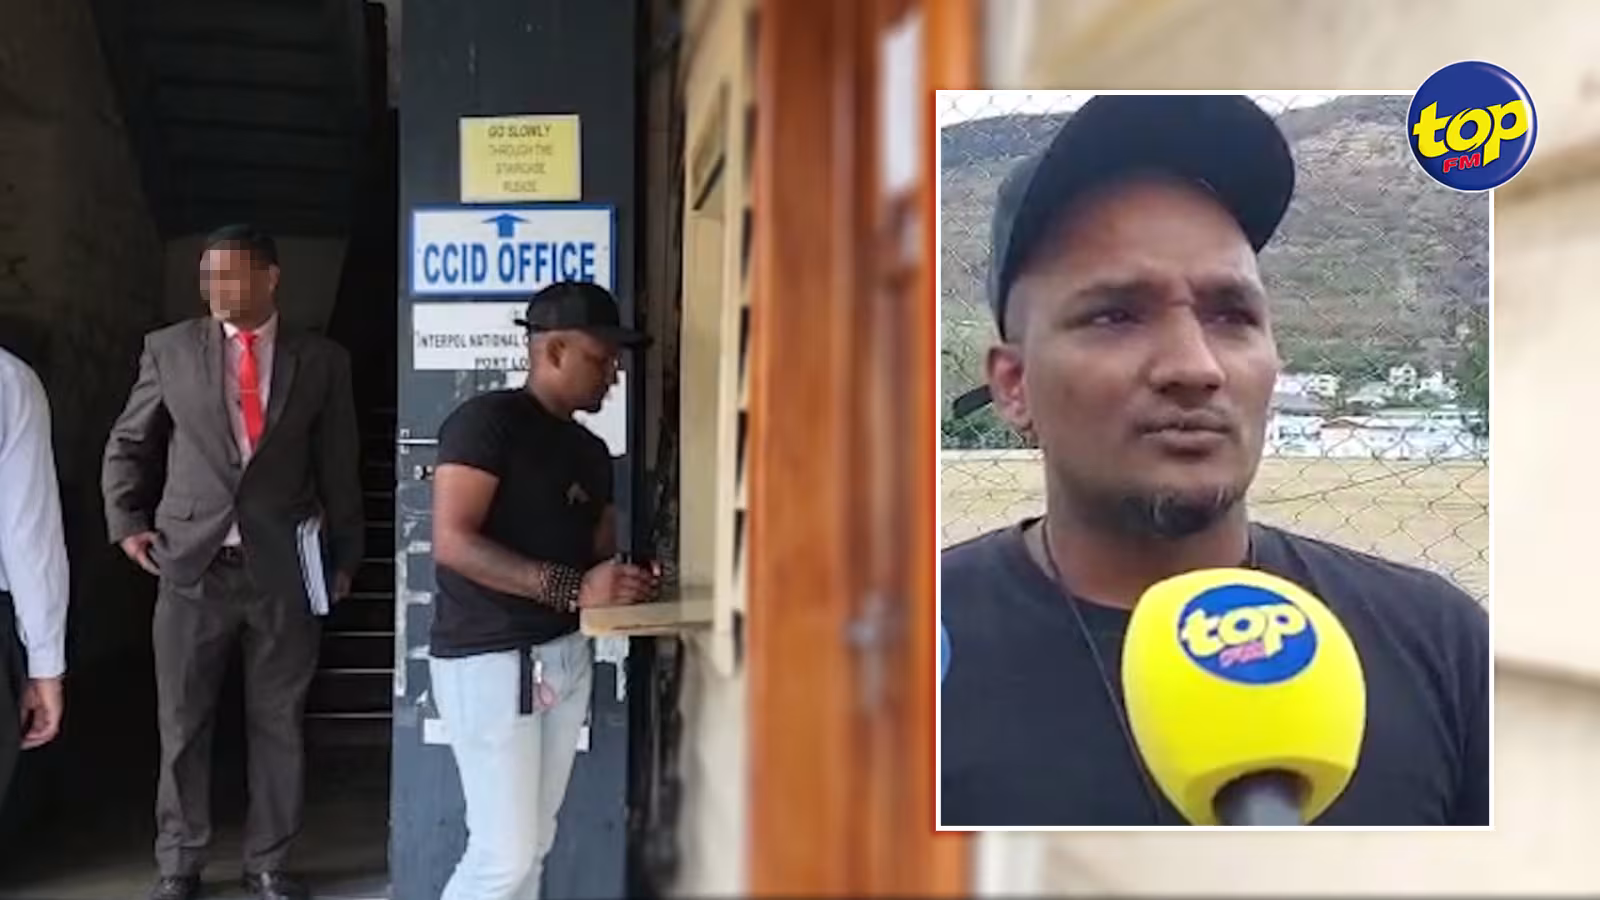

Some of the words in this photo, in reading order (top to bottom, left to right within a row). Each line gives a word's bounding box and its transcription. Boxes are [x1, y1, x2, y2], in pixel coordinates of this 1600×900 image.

[508, 124, 551, 137] SLOWLY
[424, 242, 488, 284] CCID
[498, 242, 595, 284] OFFICE
[416, 332, 466, 348] INTERPOL
[469, 333, 519, 347] NATIONAL
[475, 357, 508, 370] PORT
[1181, 604, 1307, 659] top
